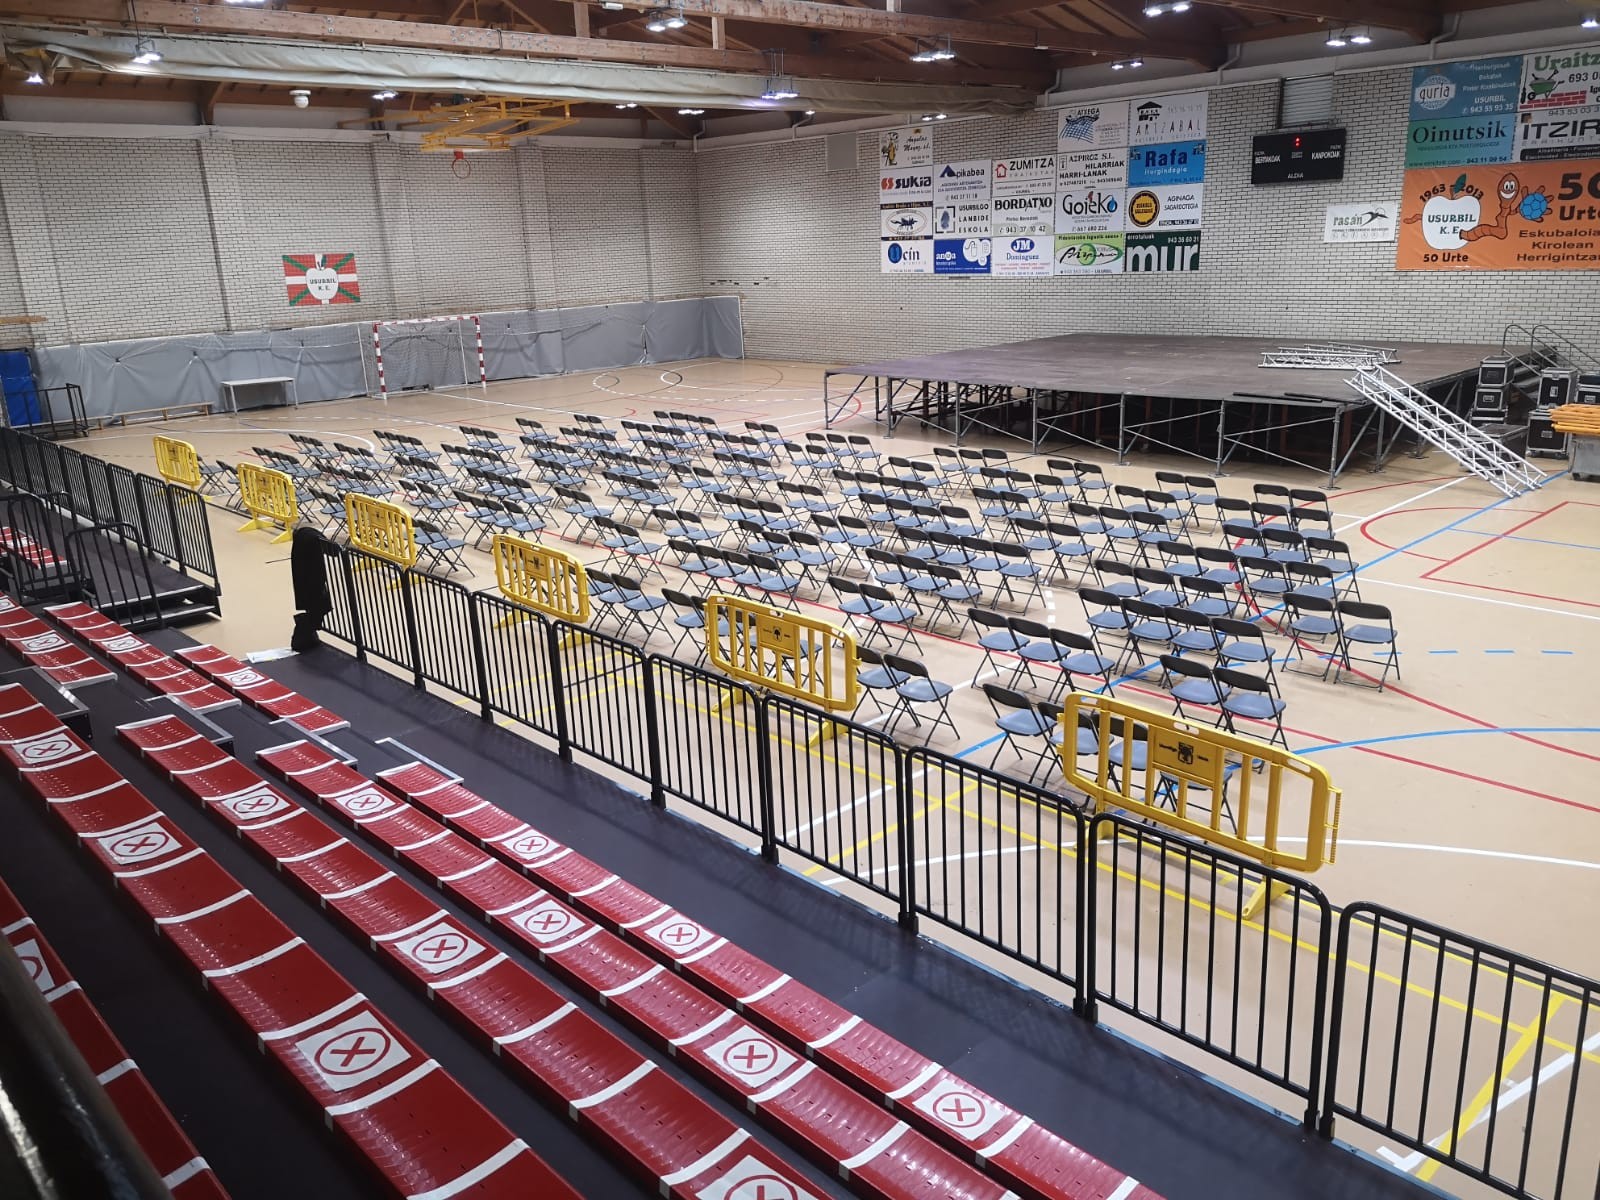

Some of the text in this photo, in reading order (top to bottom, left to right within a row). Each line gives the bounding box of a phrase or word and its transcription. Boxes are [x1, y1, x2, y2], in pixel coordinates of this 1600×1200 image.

[1568, 72, 1600, 83] 693 0
[1420, 82, 1450, 103] guria
[1475, 95, 1506, 104] USURBIL
[1548, 109, 1565, 117] 943
[1413, 121, 1507, 144] Oinutsik
[1145, 148, 1188, 167] Rafa
[1010, 158, 1054, 171] ZUMITZA
[1085, 161, 1125, 169] HILARRIAK
[1060, 170, 1107, 179] HARRI-LANAK
[895, 176, 932, 189] sukia
[1419, 184, 1446, 202] 1963
[995, 197, 1053, 212] BORDATXO
[959, 215, 989, 223] LANBIDE
[1559, 206, 1600, 221] Urt
[959, 226, 989, 234] ESKOLA
[1013, 240, 1031, 251] JM
[1532, 241, 1594, 250] Kirolean
[1126, 244, 1199, 271] mur
[1424, 252, 1469, 263] 50 Urte
